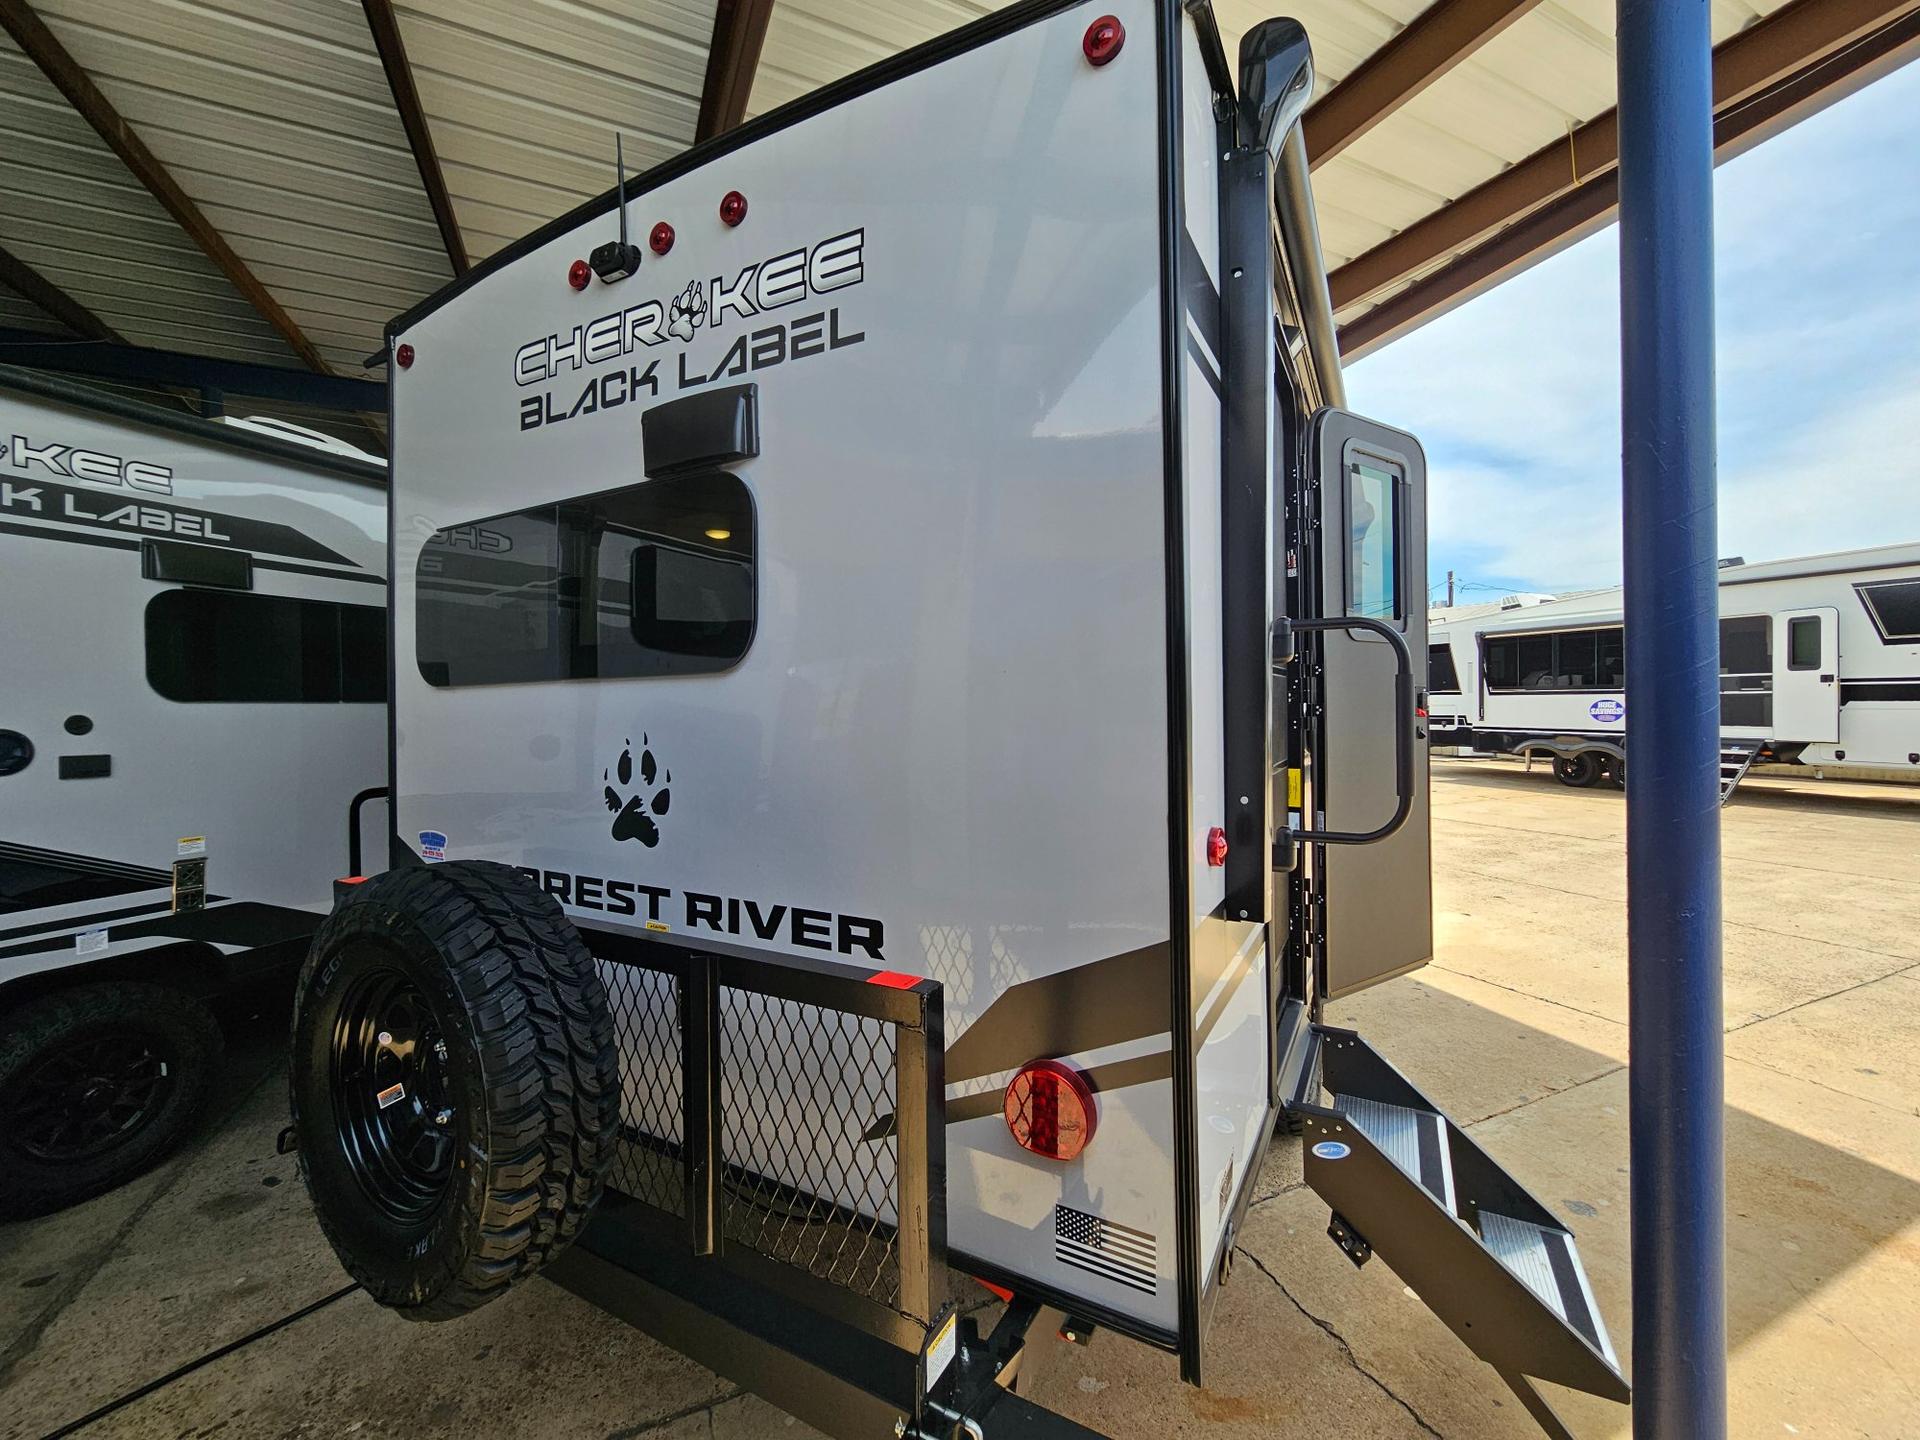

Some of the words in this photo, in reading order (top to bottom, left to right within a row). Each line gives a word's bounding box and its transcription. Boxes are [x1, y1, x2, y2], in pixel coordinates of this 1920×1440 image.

[514, 227, 865, 387] CHERKEE
[520, 359, 661, 431] BLACK
[678, 307, 865, 389] LABEL
[64, 493, 231, 542] LABEL
[683, 891, 886, 961] RIVER
